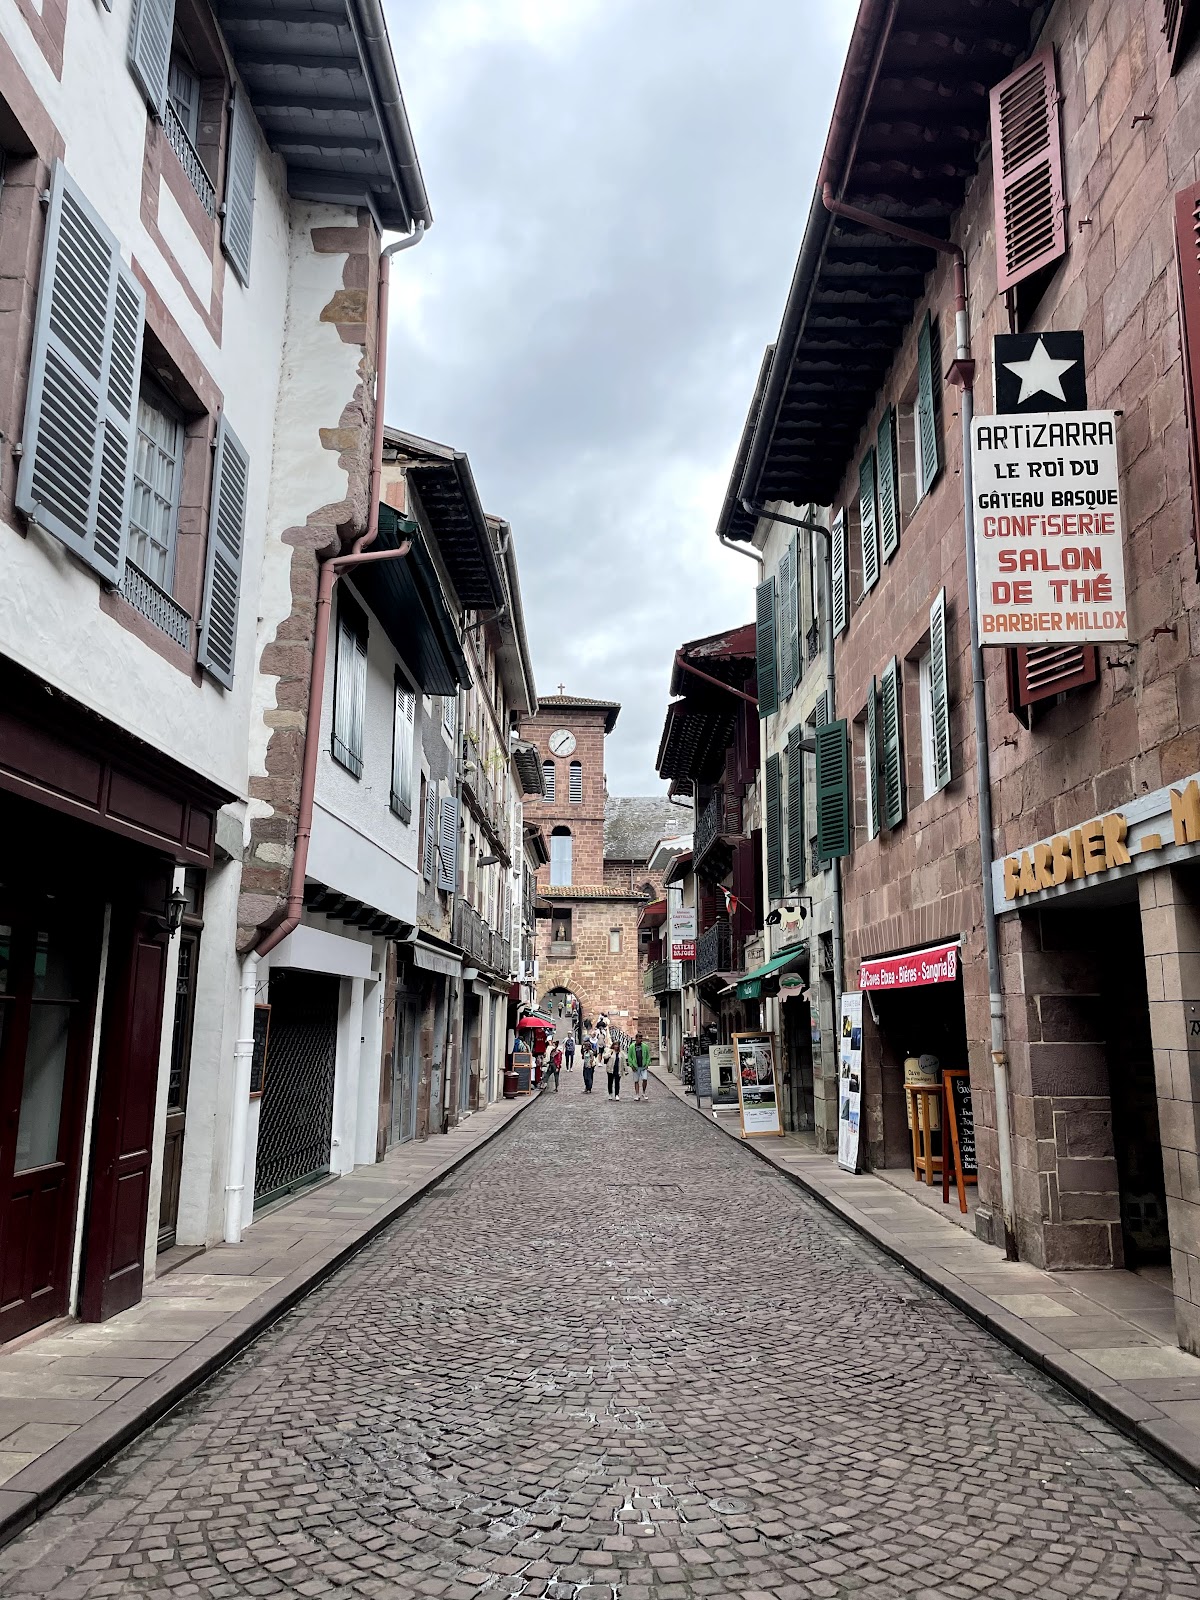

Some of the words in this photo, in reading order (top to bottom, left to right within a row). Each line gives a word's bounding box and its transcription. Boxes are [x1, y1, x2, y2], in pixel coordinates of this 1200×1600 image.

[993, 462, 1020, 479] LE
[1069, 459, 1099, 476] DU
[978, 490, 1044, 509] GÂTEAU
[1051, 489, 1118, 510] BASQUE
[998, 546, 1102, 572] SALON
[991, 580, 1033, 605] DE
[1048, 573, 1113, 604] THÉ
[1003, 812, 1132, 901] BARBIER
[865, 970, 880, 987] Caves
[898, 965, 917, 984] Bières
[921, 957, 947, 983] Sangria
